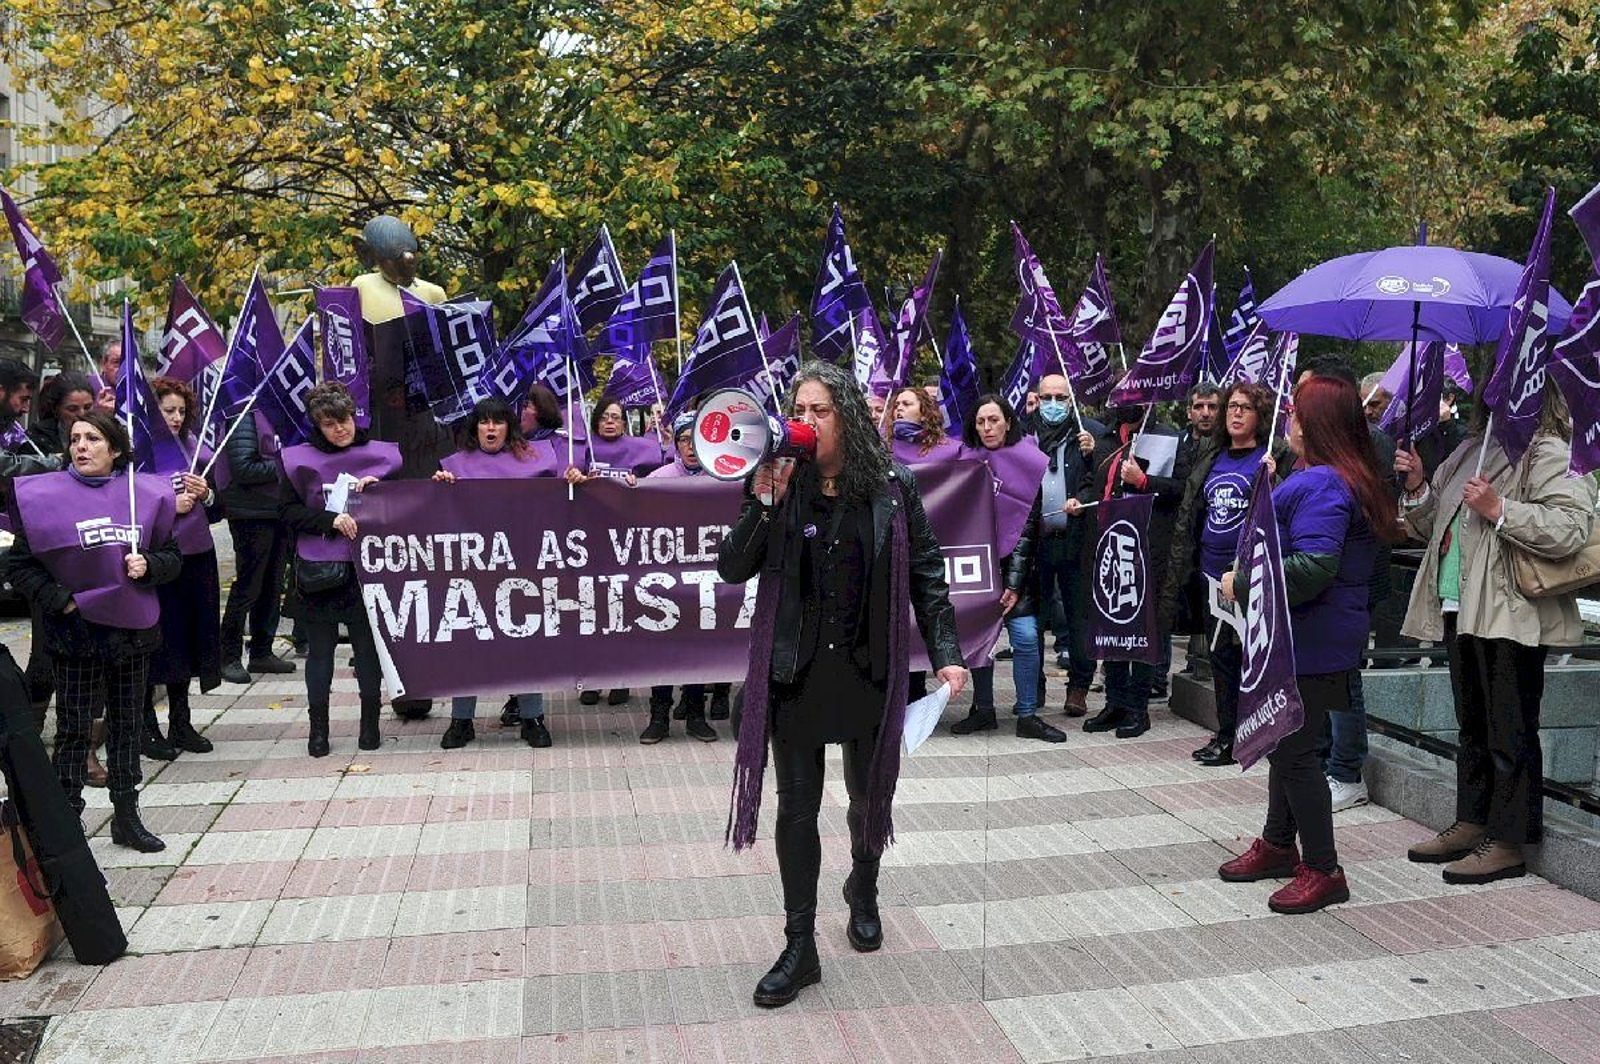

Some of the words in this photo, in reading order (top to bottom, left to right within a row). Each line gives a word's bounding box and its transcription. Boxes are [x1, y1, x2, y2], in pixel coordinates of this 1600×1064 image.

[360, 531, 516, 573] CONTRA
[537, 529, 589, 570] AS
[608, 524, 733, 566] VIOLE
[1118, 534, 1138, 608] UGT
[1095, 633, 1149, 651] www.ugt.es
[1235, 687, 1288, 744] www.ugt.es
